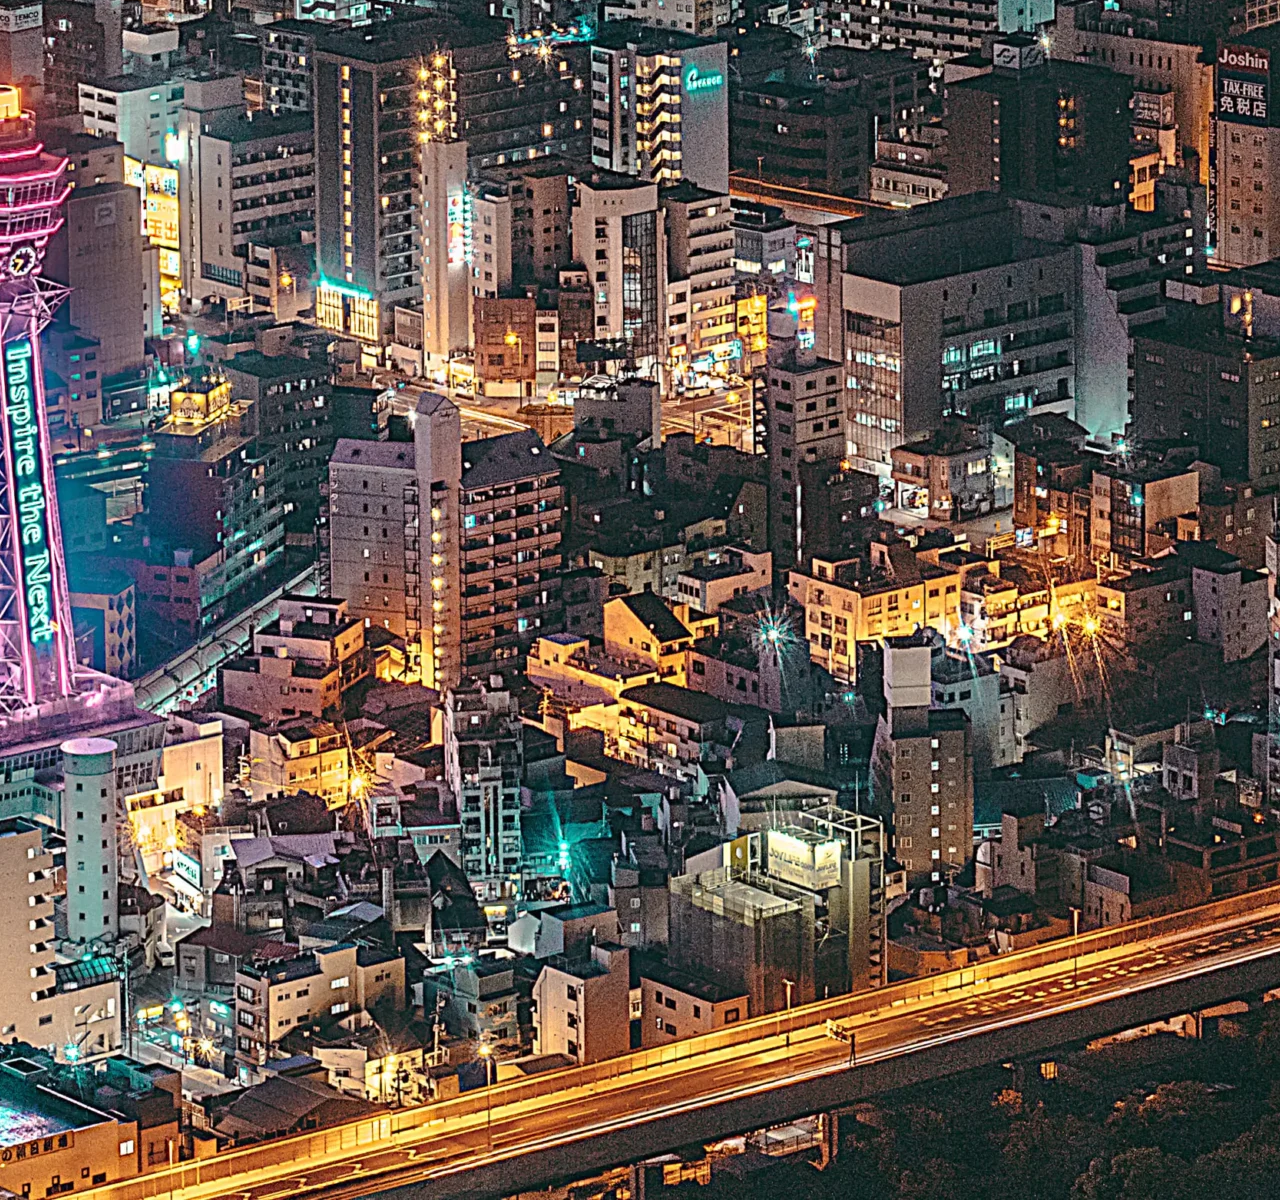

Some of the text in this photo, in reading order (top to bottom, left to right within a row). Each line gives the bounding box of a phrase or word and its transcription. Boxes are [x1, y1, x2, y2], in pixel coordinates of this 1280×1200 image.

[15, 10, 40, 24] TEMCO
[1218, 50, 1270, 71] Joshin
[1220, 95, 1268, 118] 免税店
[6, 341, 57, 644] Inspire the Next
